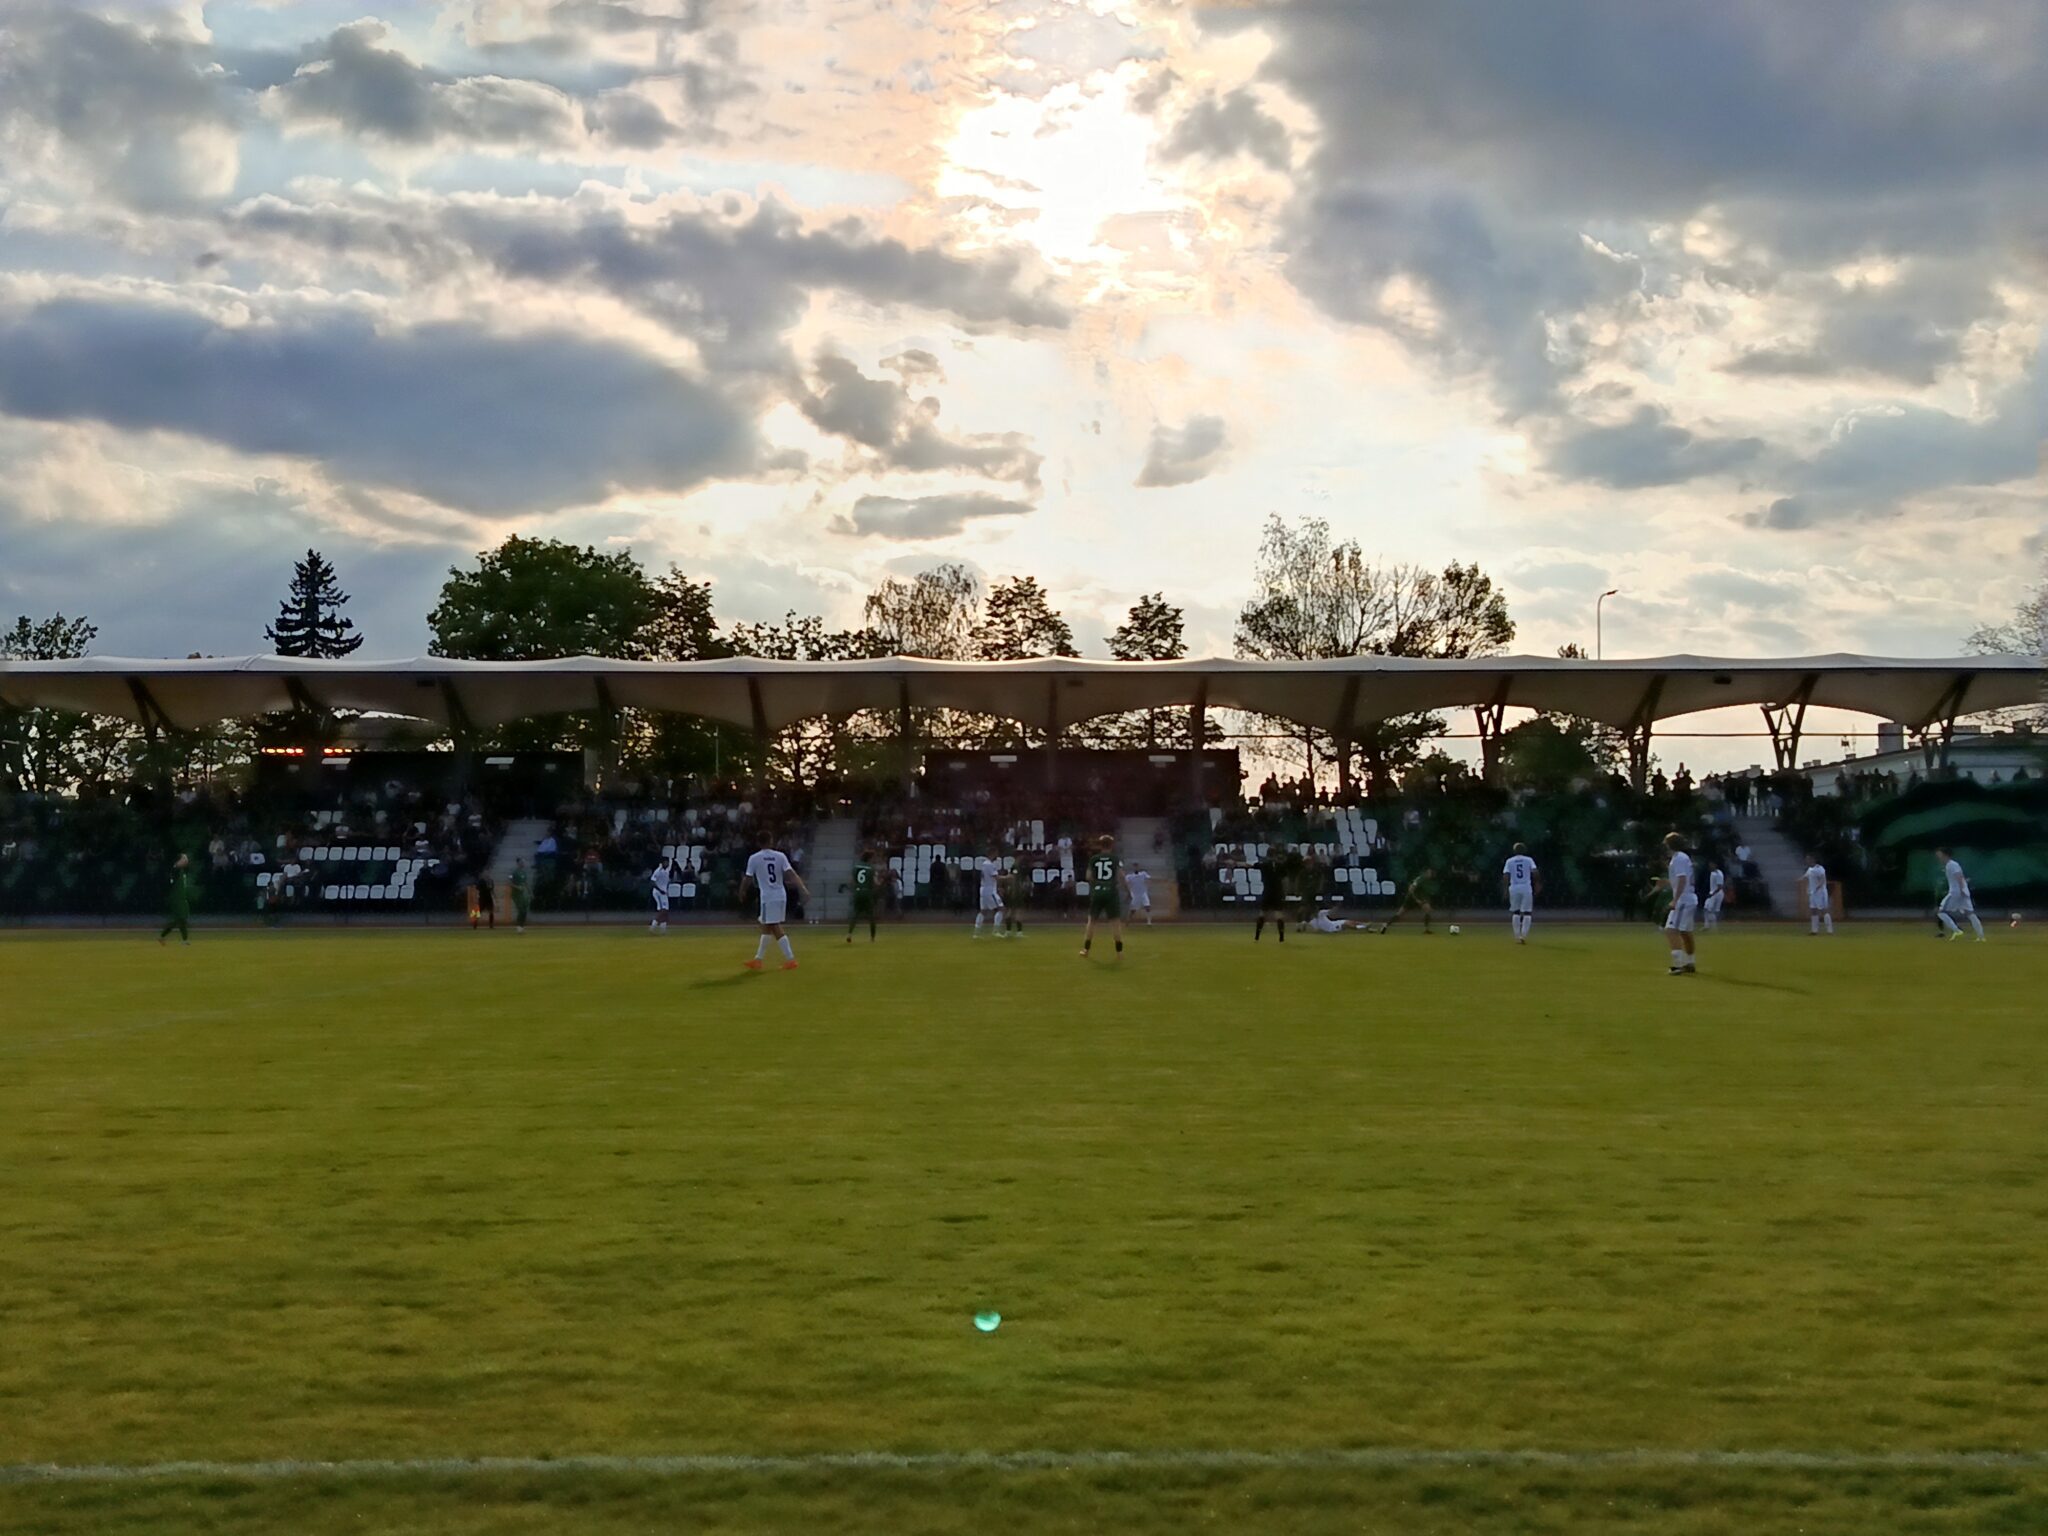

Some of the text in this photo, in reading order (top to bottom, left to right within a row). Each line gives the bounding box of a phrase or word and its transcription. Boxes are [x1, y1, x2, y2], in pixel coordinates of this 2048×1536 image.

[857, 869, 866, 883] 6
[1094, 861, 1113, 880] 15
[1516, 864, 1524, 879] 5
